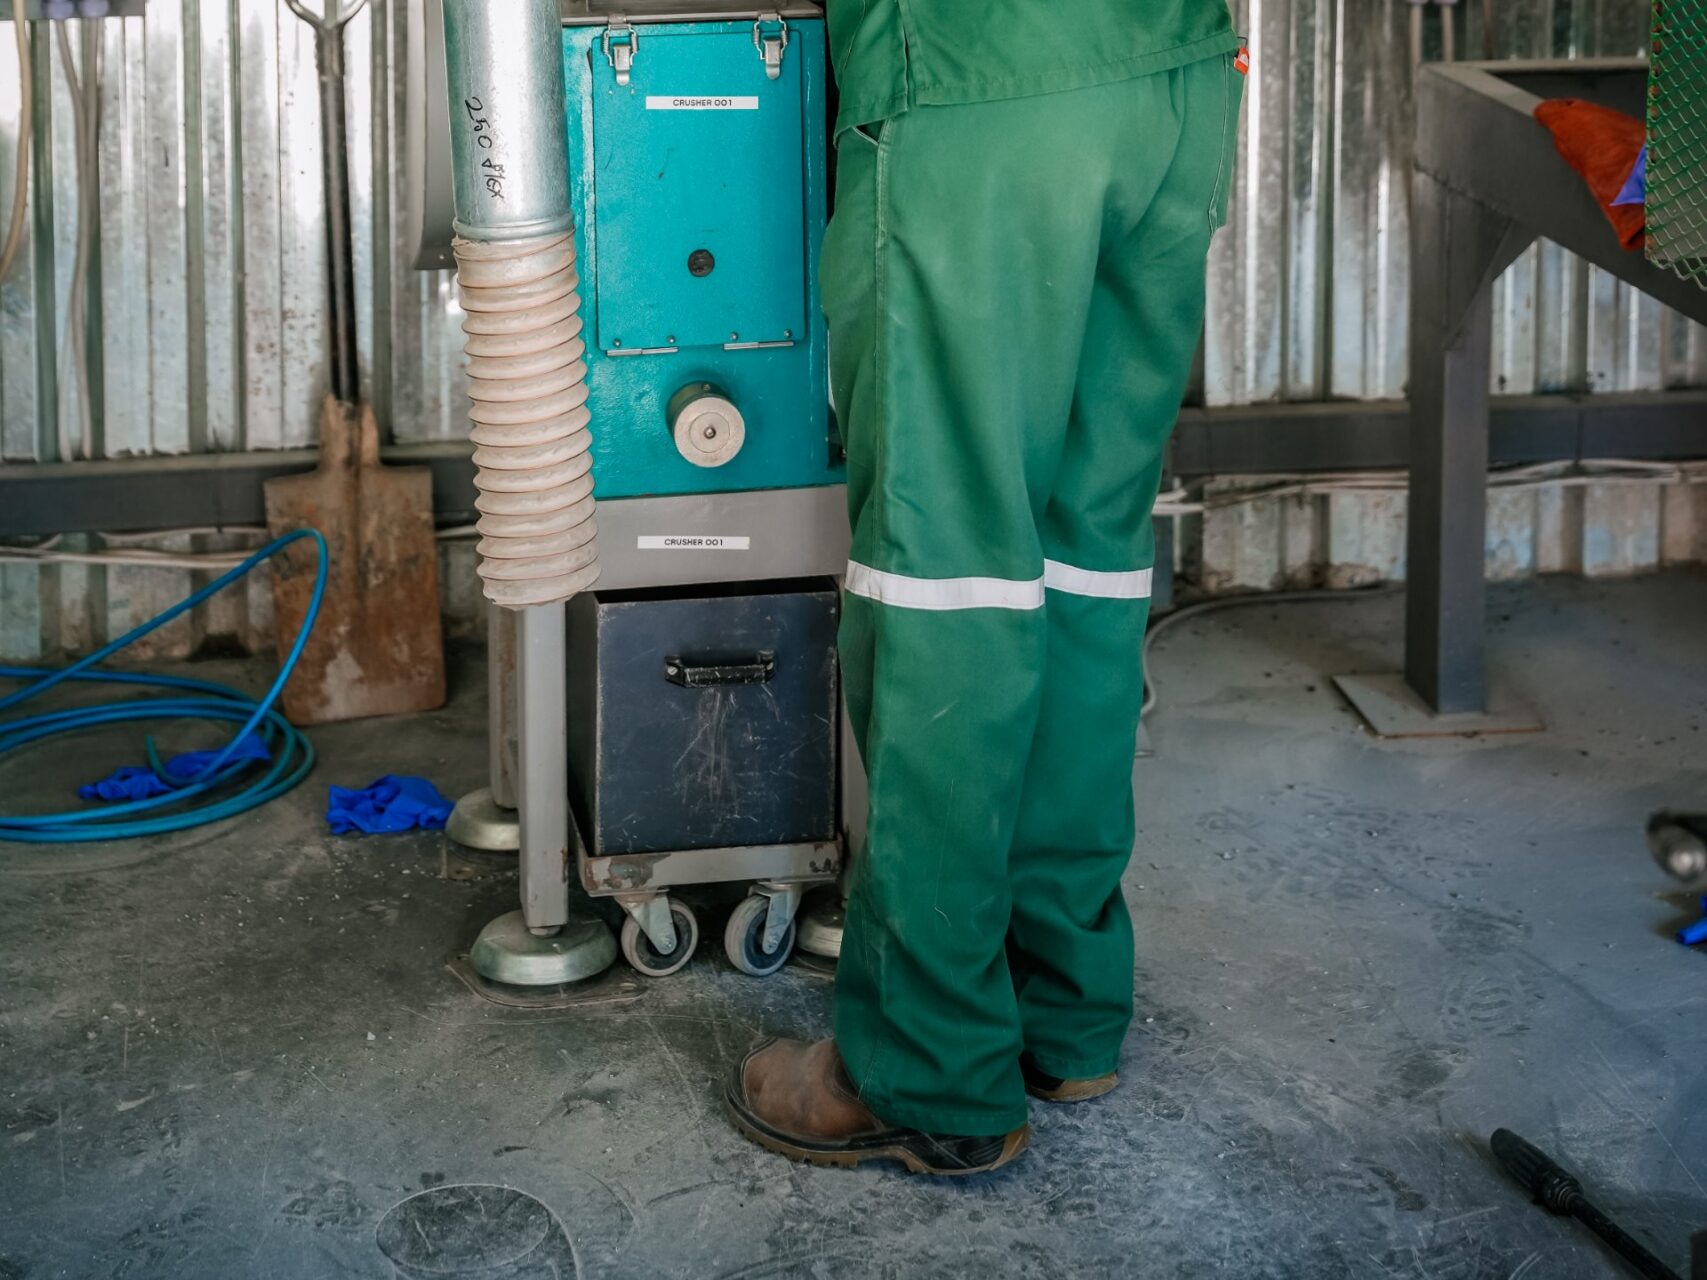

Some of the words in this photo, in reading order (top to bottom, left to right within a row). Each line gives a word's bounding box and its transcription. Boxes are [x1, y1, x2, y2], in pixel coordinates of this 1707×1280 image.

[672, 99, 712, 107] CRUSHER
[714, 99, 732, 107] 001
[464, 96, 493, 149] 250
[664, 538, 703, 546] CRUSHER
[705, 538, 723, 546] 001
